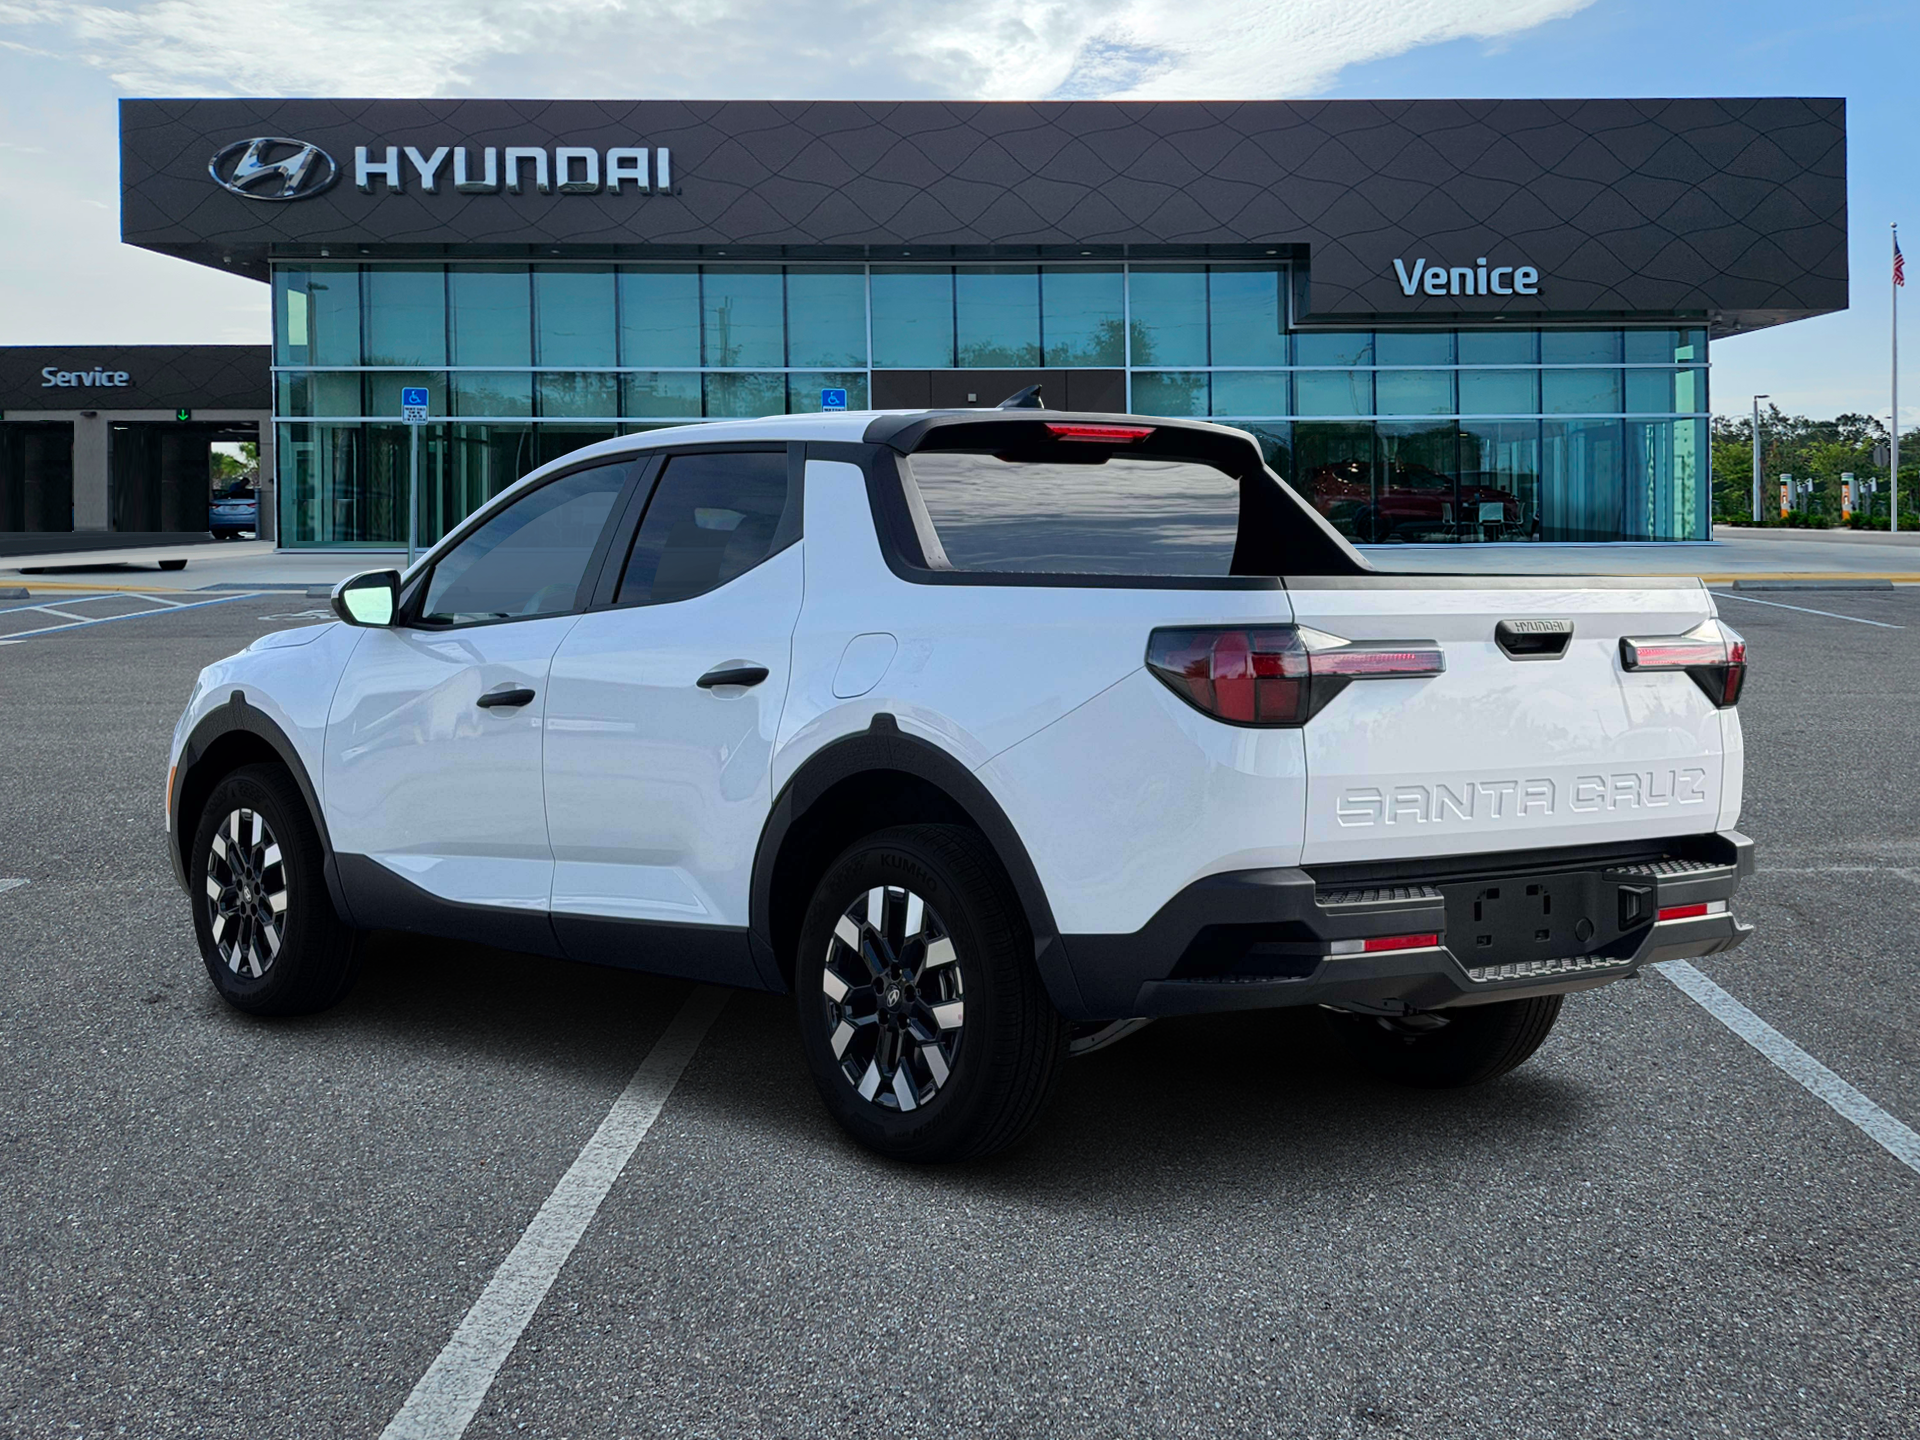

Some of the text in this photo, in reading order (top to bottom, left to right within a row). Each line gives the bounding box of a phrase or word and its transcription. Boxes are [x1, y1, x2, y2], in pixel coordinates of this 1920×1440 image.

[354, 146, 672, 194] HYUNDAI
[1393, 256, 1539, 296] Venice
[41, 366, 130, 387] Service
[1514, 621, 1565, 633] HYUNDAI
[1336, 767, 1706, 827] SANTA CRUZ
[880, 853, 938, 892] KUMHO
